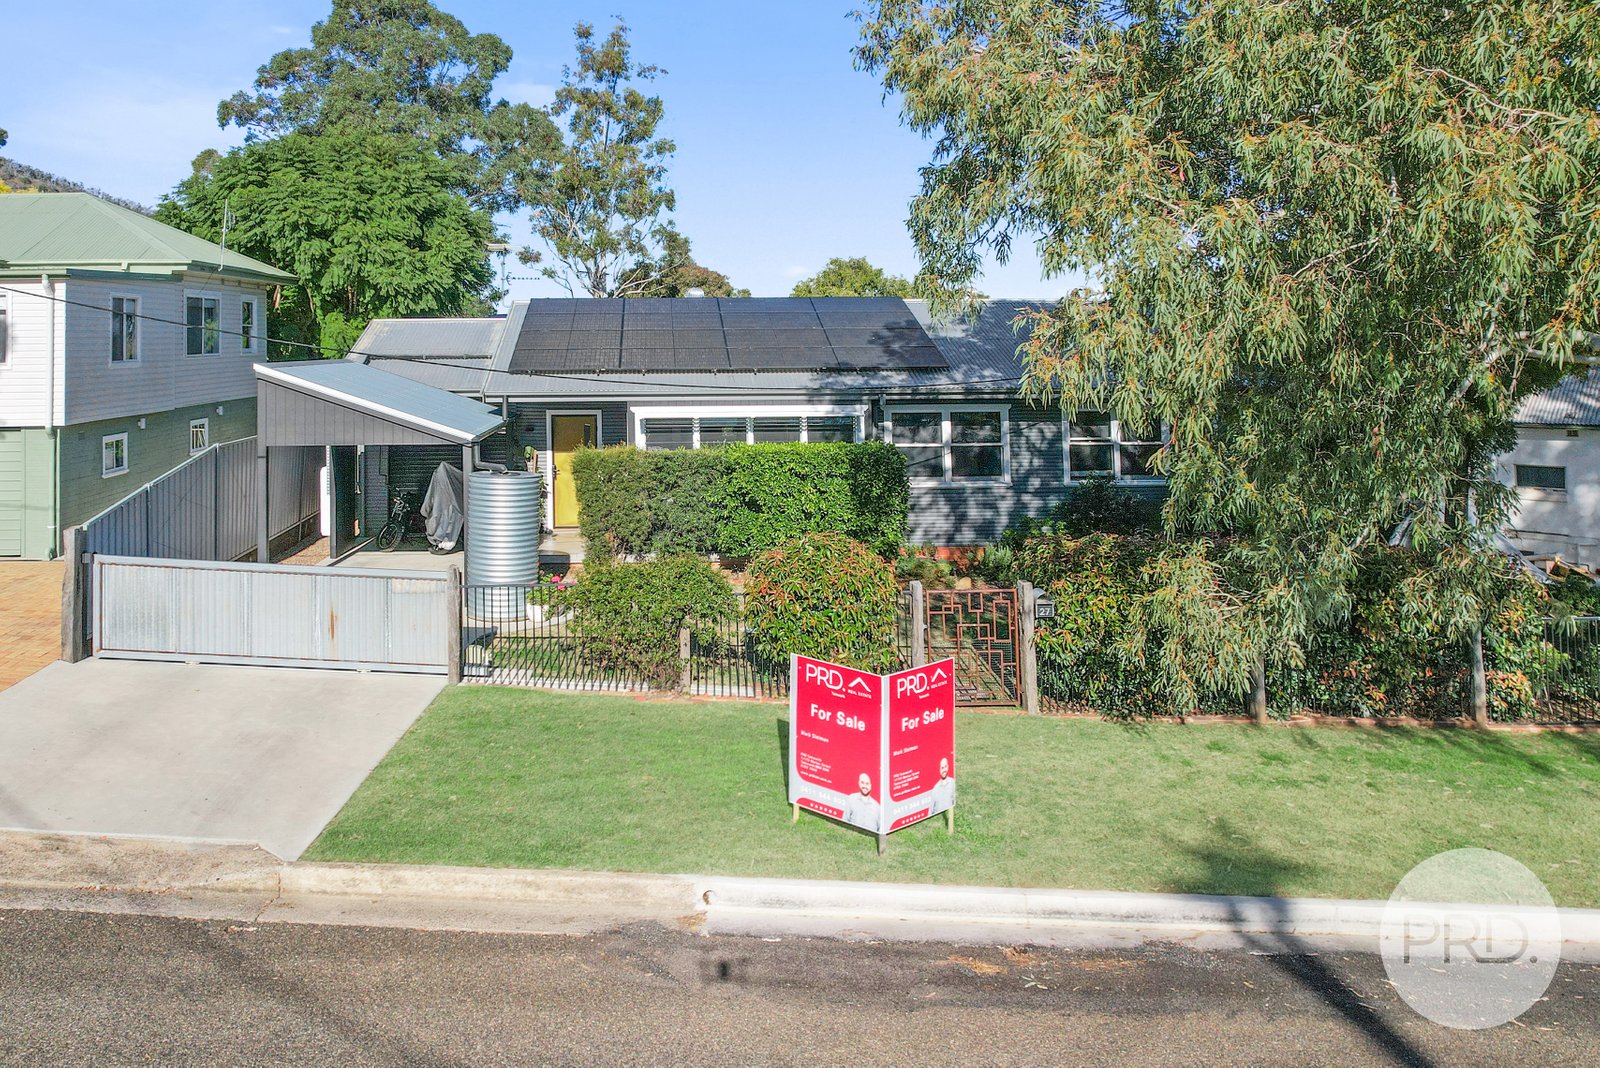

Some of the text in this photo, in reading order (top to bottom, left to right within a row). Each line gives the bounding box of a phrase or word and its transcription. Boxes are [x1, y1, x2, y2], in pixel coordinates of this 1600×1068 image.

[1039, 607, 1051, 616] 27
[810, 703, 866, 731] For Sale
[901, 707, 945, 732] For Sale
